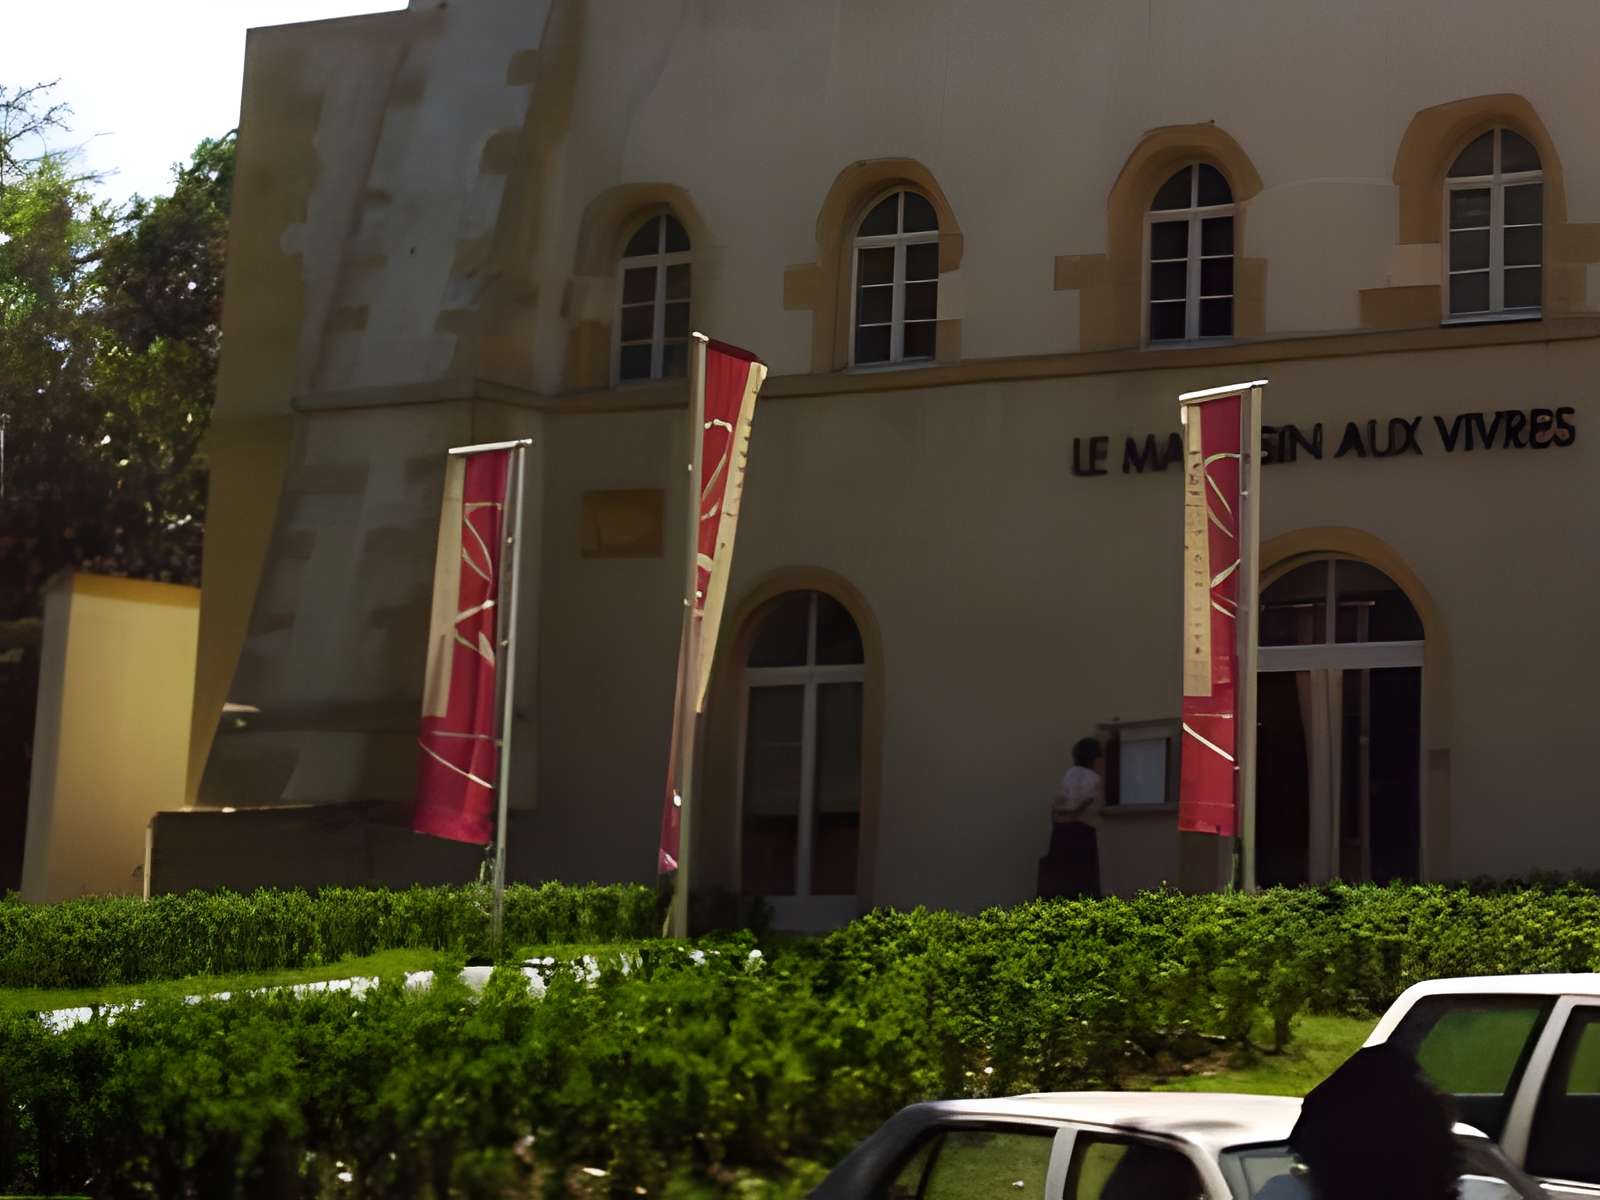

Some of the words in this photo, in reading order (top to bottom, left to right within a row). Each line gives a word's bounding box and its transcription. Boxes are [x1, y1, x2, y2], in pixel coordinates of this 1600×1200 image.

[1072, 435, 1109, 477] LE
[1122, 422, 1323, 474] MASIN
[1334, 415, 1423, 459] AUX
[1433, 406, 1576, 453] VIVRES
